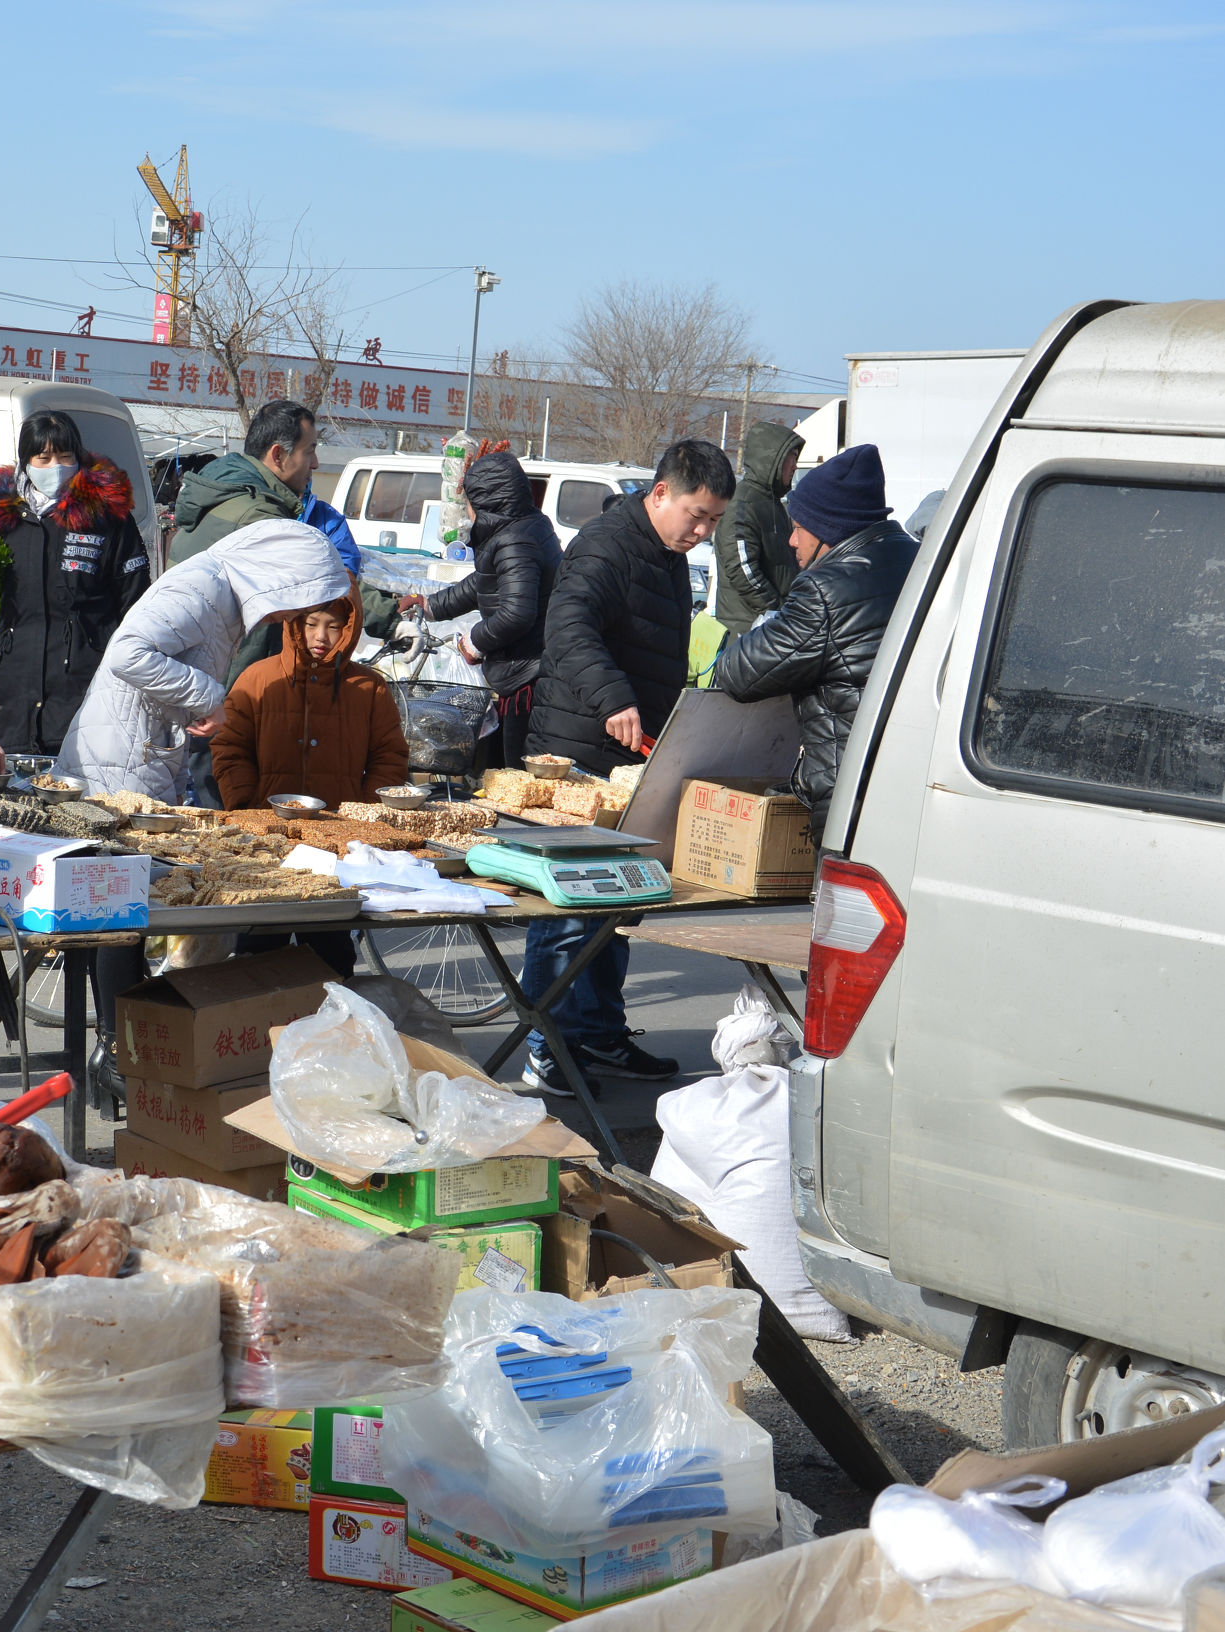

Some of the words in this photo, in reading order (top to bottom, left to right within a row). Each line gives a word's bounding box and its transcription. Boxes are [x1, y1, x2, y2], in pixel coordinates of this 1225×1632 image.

[0, 345, 90, 372] 九虹重工
[32, 373, 57, 383] HEAV
[58, 375, 92, 385] INDUSTRY
[136, 1020, 170, 1042] 易碎
[135, 1084, 207, 1144] 铁棍山药饼
